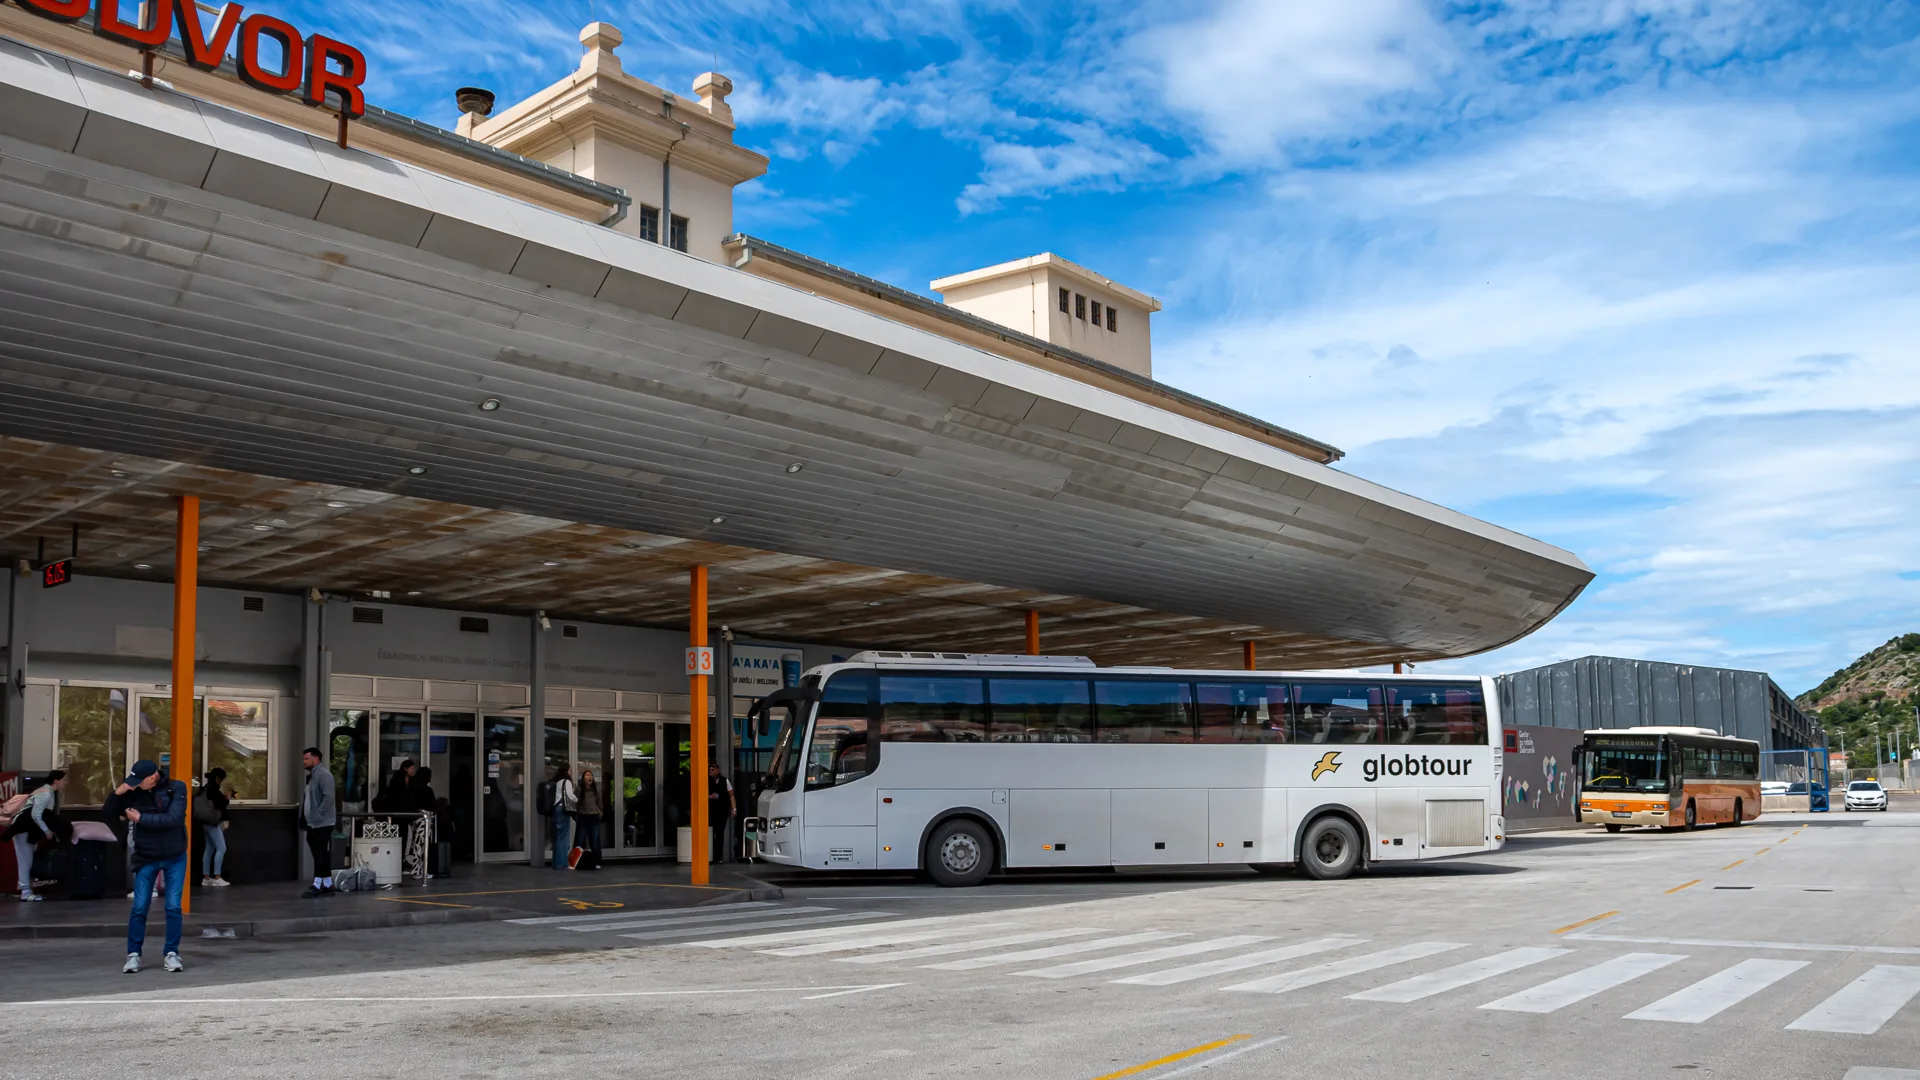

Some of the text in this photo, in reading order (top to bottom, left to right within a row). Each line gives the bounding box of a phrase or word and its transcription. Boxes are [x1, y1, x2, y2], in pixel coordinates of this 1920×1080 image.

[687, 651, 697, 670] 3
[701, 651, 711, 670] 3
[1362, 754, 1472, 783] globtour
